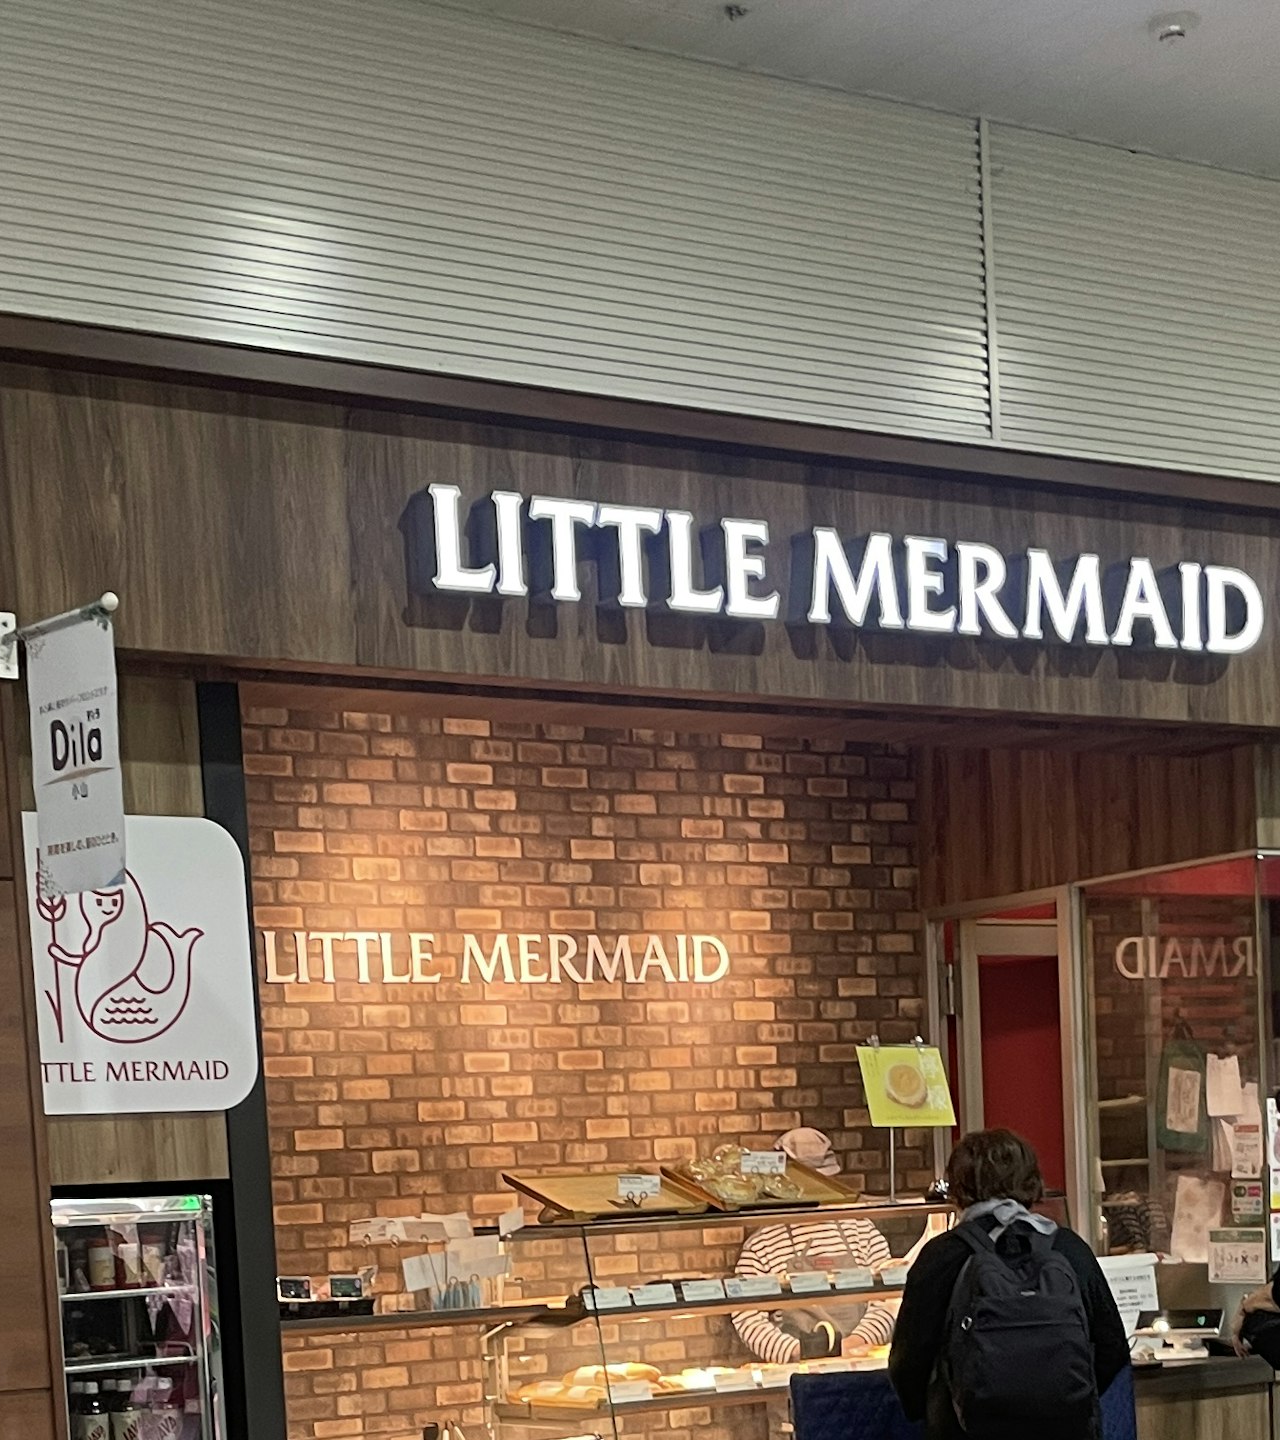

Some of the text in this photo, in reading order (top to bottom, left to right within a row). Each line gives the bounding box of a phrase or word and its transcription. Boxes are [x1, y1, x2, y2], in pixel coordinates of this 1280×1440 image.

[426, 482, 1264, 654] LITTLE MERMAID
[263, 931, 730, 984] LITTLE MERMAID
[106, 1060, 229, 1083] MERMAID
